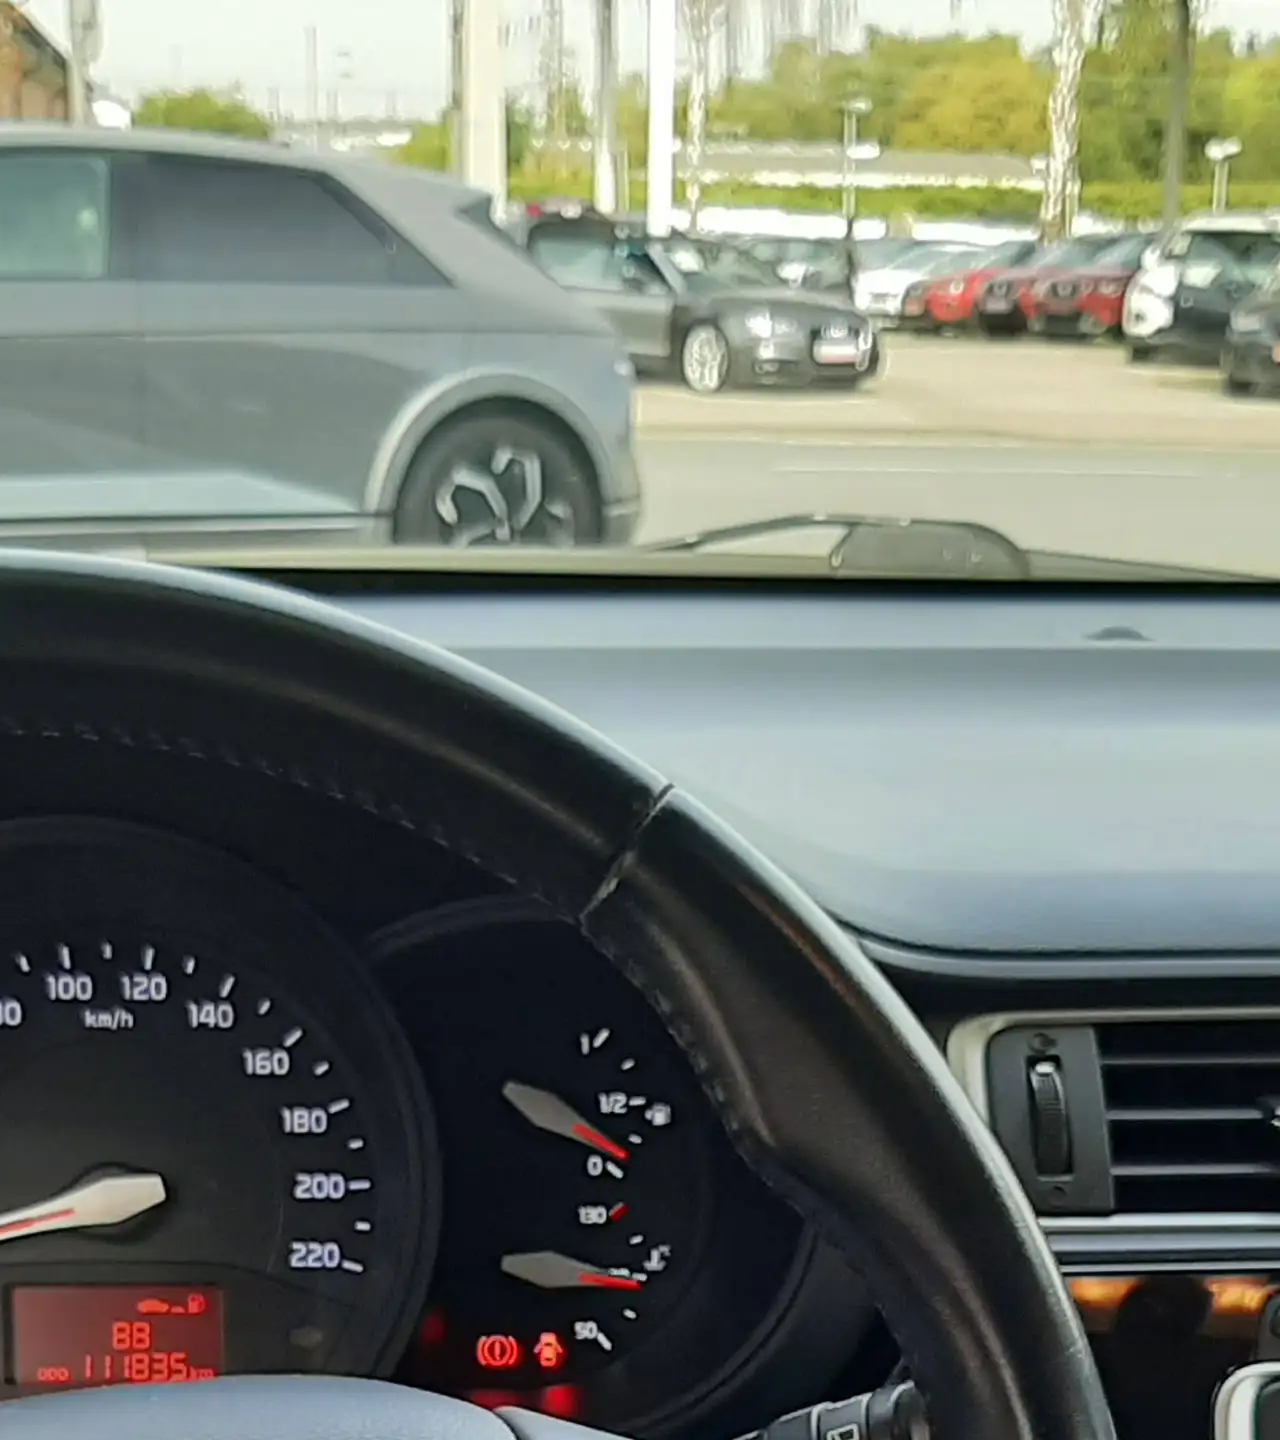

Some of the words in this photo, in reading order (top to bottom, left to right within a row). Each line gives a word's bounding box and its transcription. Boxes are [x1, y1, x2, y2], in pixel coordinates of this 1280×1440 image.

[46, 975, 92, 1001] 100
[121, 976, 167, 1001] 120
[84, 1009, 133, 1030] km/h
[188, 1003, 234, 1029] 140
[243, 1050, 289, 1075] 160
[282, 1108, 327, 1133] 180
[586, 1155, 603, 1176] 0
[293, 1174, 345, 1200] 200
[289, 1243, 340, 1269] 220
[85, 1353, 187, 1381] 111835
